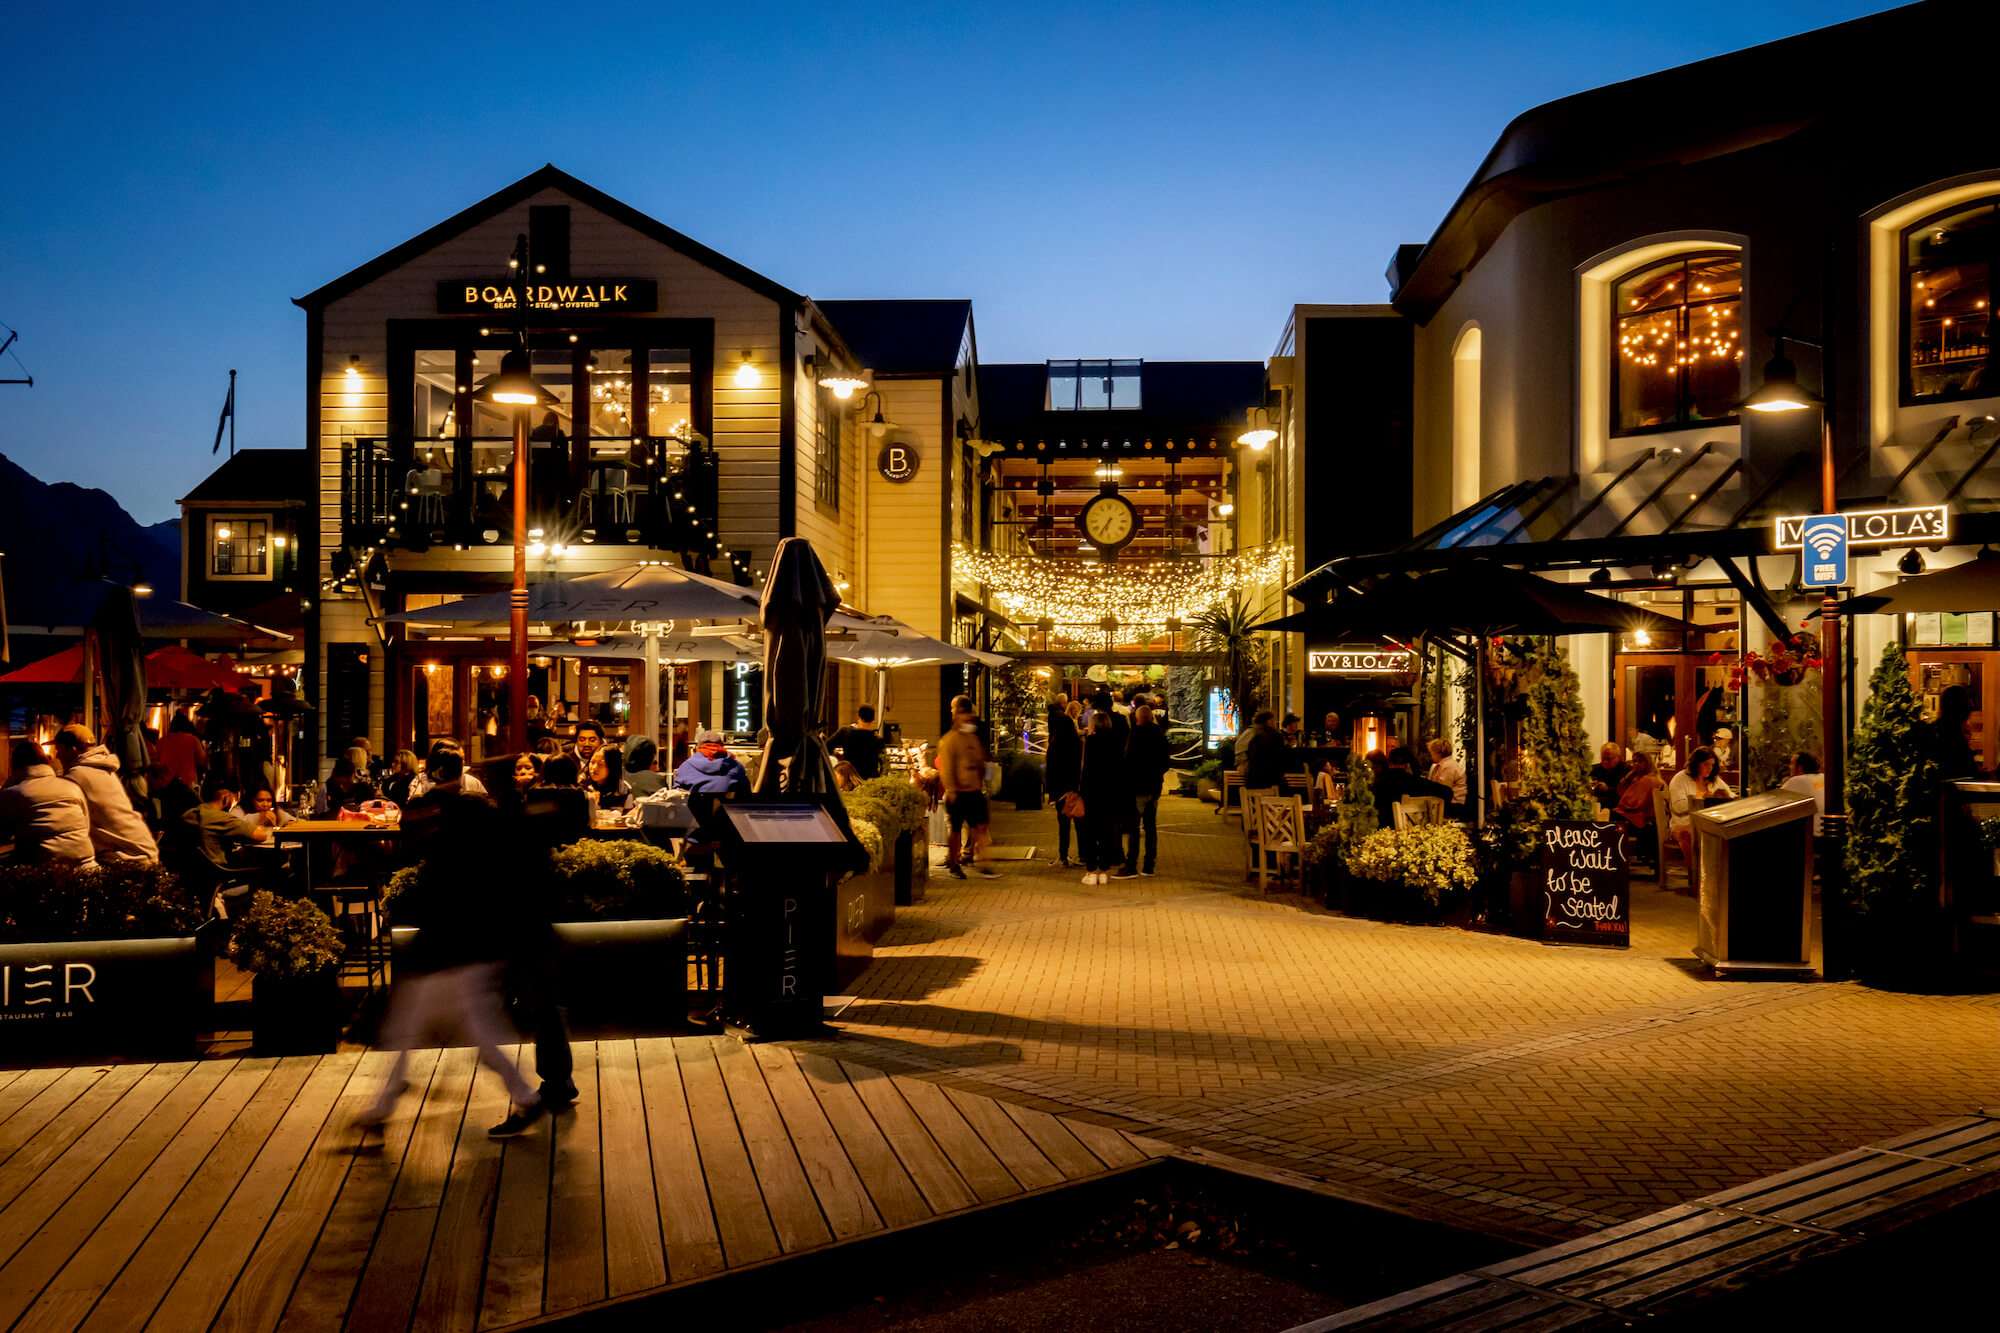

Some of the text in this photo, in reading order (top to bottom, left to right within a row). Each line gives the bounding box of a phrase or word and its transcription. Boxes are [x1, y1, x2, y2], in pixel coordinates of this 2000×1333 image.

[465, 284, 628, 303] BOARDWALK
[535, 301, 557, 309] STEA
[565, 301, 600, 309] OYSTERS
[889, 447, 908, 472] B
[1814, 563, 1837, 573] FREE
[534, 599, 658, 612] PIER
[612, 640, 698, 653] PIER
[736, 662, 750, 732] PIER
[1547, 868, 1594, 896] to be
[782, 898, 798, 996] PIER
[3, 963, 97, 1007] IER
[0, 1011, 46, 1022] STAURANT
